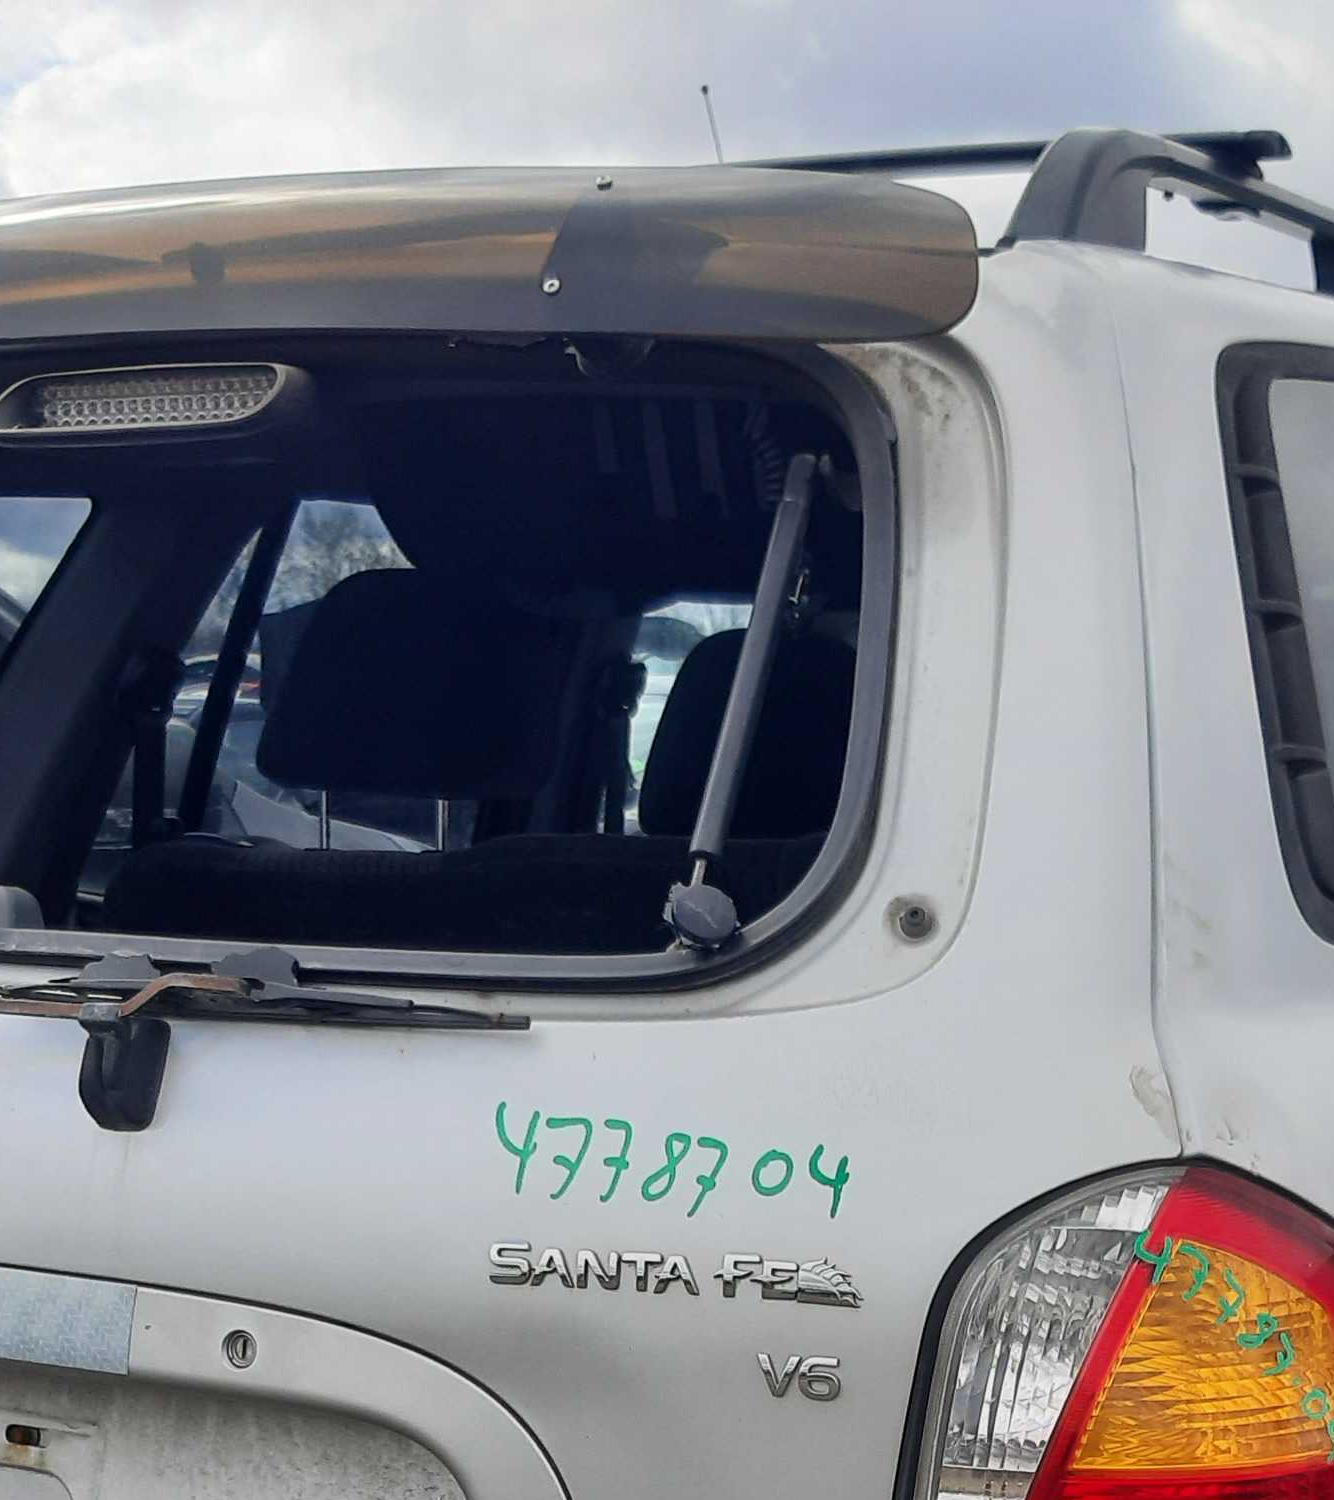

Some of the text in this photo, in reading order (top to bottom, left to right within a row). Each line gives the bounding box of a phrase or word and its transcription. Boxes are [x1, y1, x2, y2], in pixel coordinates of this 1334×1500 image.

[495, 1100, 851, 1219] 4778704
[488, 1241, 700, 1297] SANTA
[757, 1352, 842, 1402] V6
